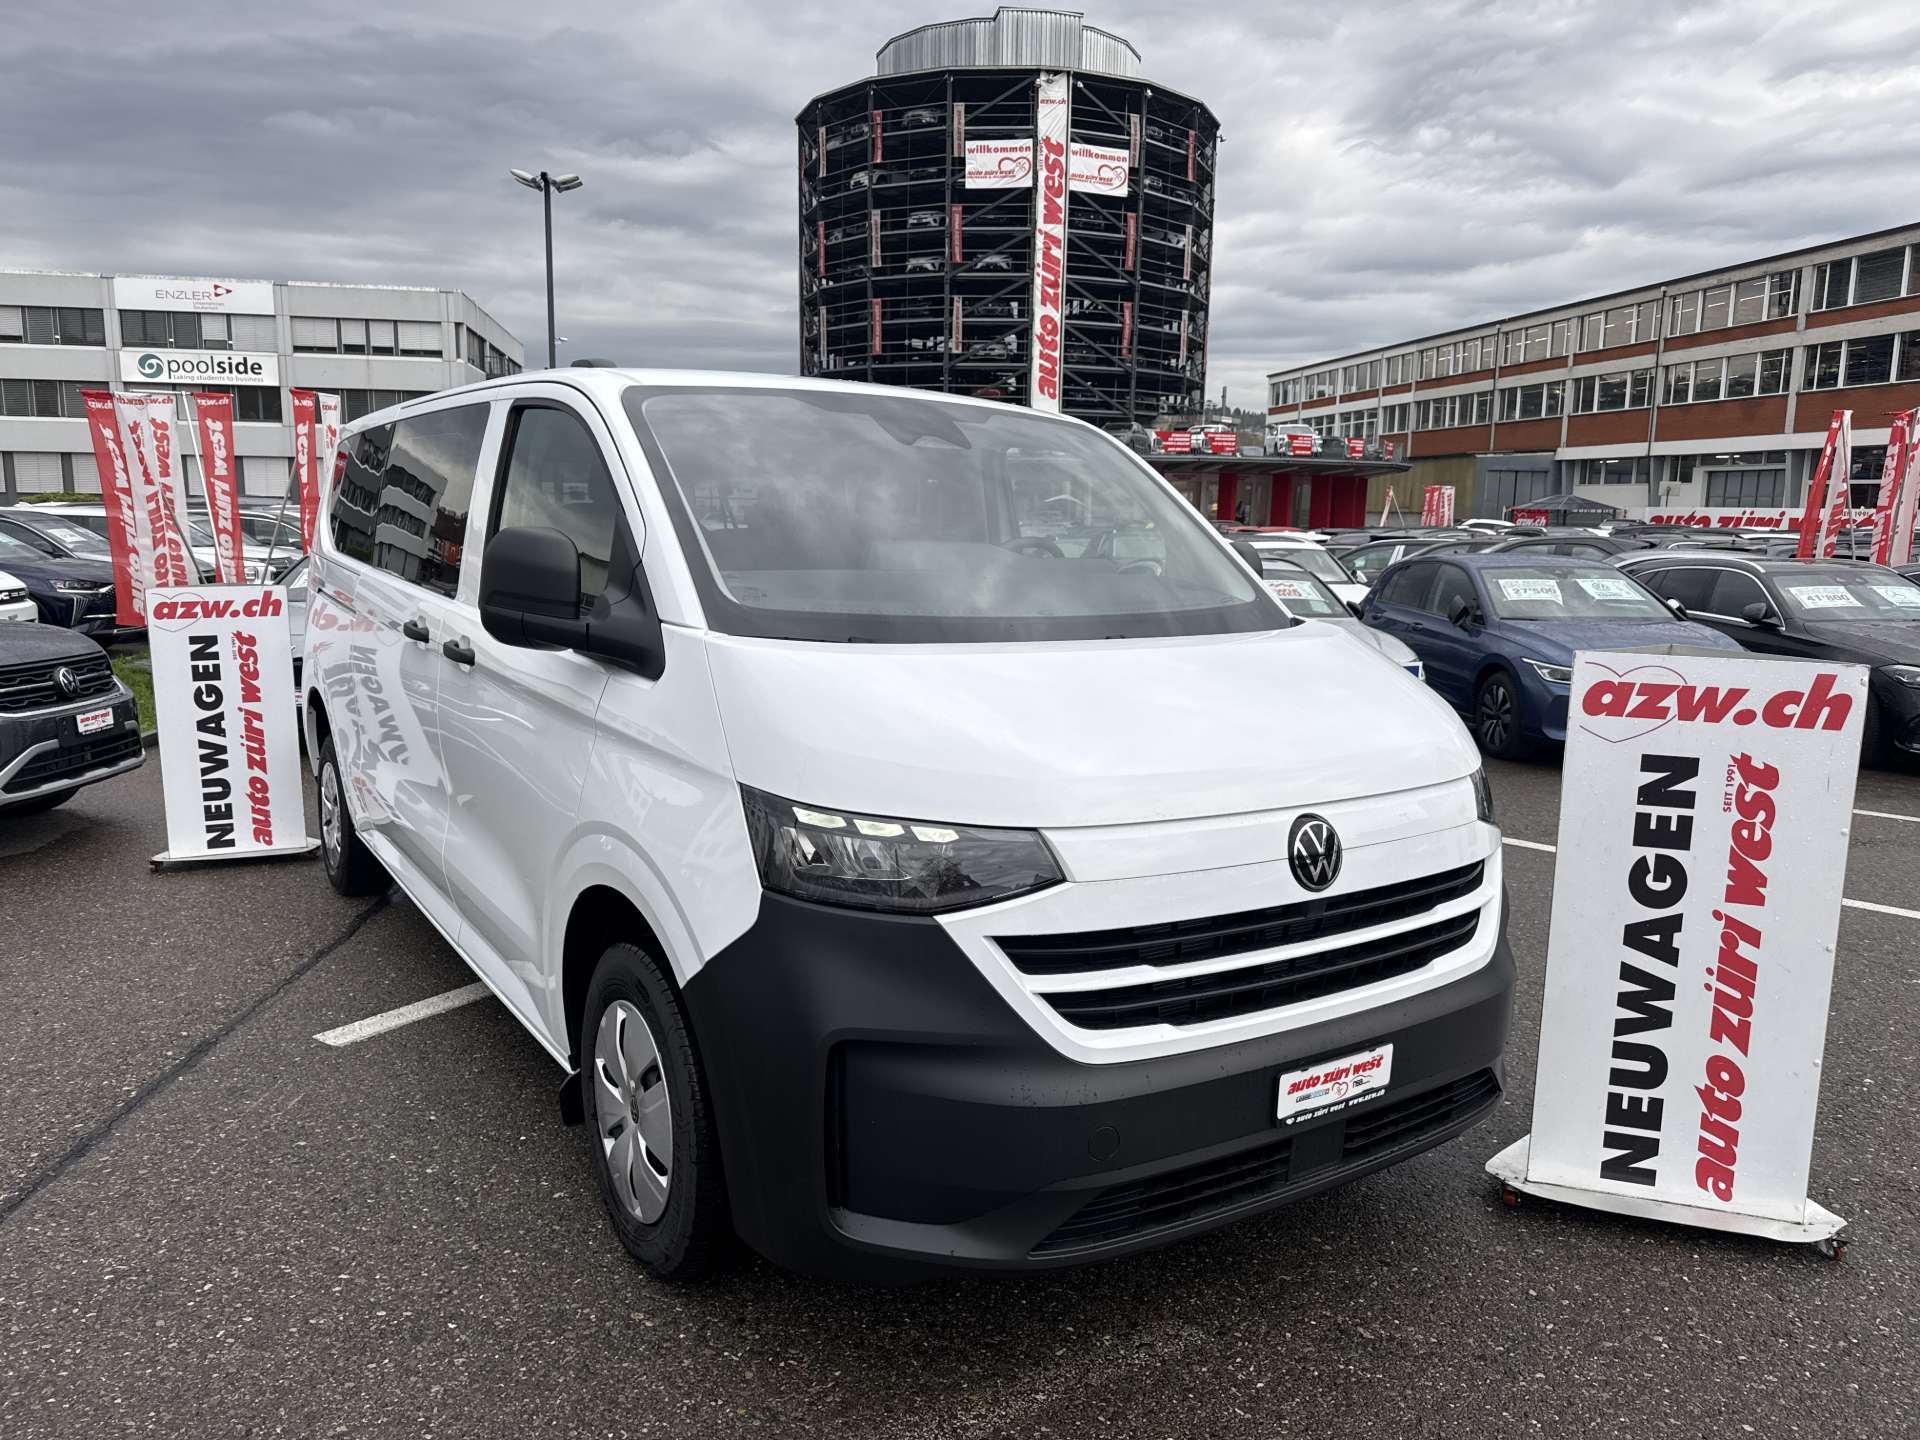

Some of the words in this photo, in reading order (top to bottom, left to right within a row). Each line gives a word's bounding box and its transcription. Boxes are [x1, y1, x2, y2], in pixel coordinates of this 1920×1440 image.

[1040, 97, 1066, 105] azw.ch
[967, 144, 1031, 154] willkommen
[1071, 148, 1128, 162] willkommen
[1041, 135, 1066, 225] west
[155, 289, 212, 301] ENZLER
[1036, 229, 1063, 313] züri
[167, 355, 263, 380] poolside
[173, 374, 195, 382] taking
[196, 374, 226, 382] students
[235, 375, 264, 383] business
[1034, 314, 1059, 400] auto
[99, 423, 129, 488] west
[149, 417, 170, 478] west
[206, 417, 229, 476] west
[210, 477, 234, 532] züri
[153, 590, 282, 620] azw.ch
[230, 630, 262, 704] west
[1581, 673, 1853, 732] azw.ch
[188, 634, 236, 850] NEUWAGEN
[237, 706, 268, 776] züri
[1723, 791, 1733, 813] SEIT
[1726, 764, 1736, 788] 1991
[244, 775, 273, 847] auto
[1724, 752, 1780, 908] west
[1600, 752, 1700, 1188] NEUWAGEN
[1703, 909, 1762, 1059] züri
[1287, 1073, 1321, 1095] auto
[1320, 1063, 1352, 1085] züri
[1353, 1055, 1384, 1076] west
[1295, 1112, 1313, 1123] auto
[1329, 1102, 1346, 1112] west
[1694, 1054, 1747, 1202] auto
